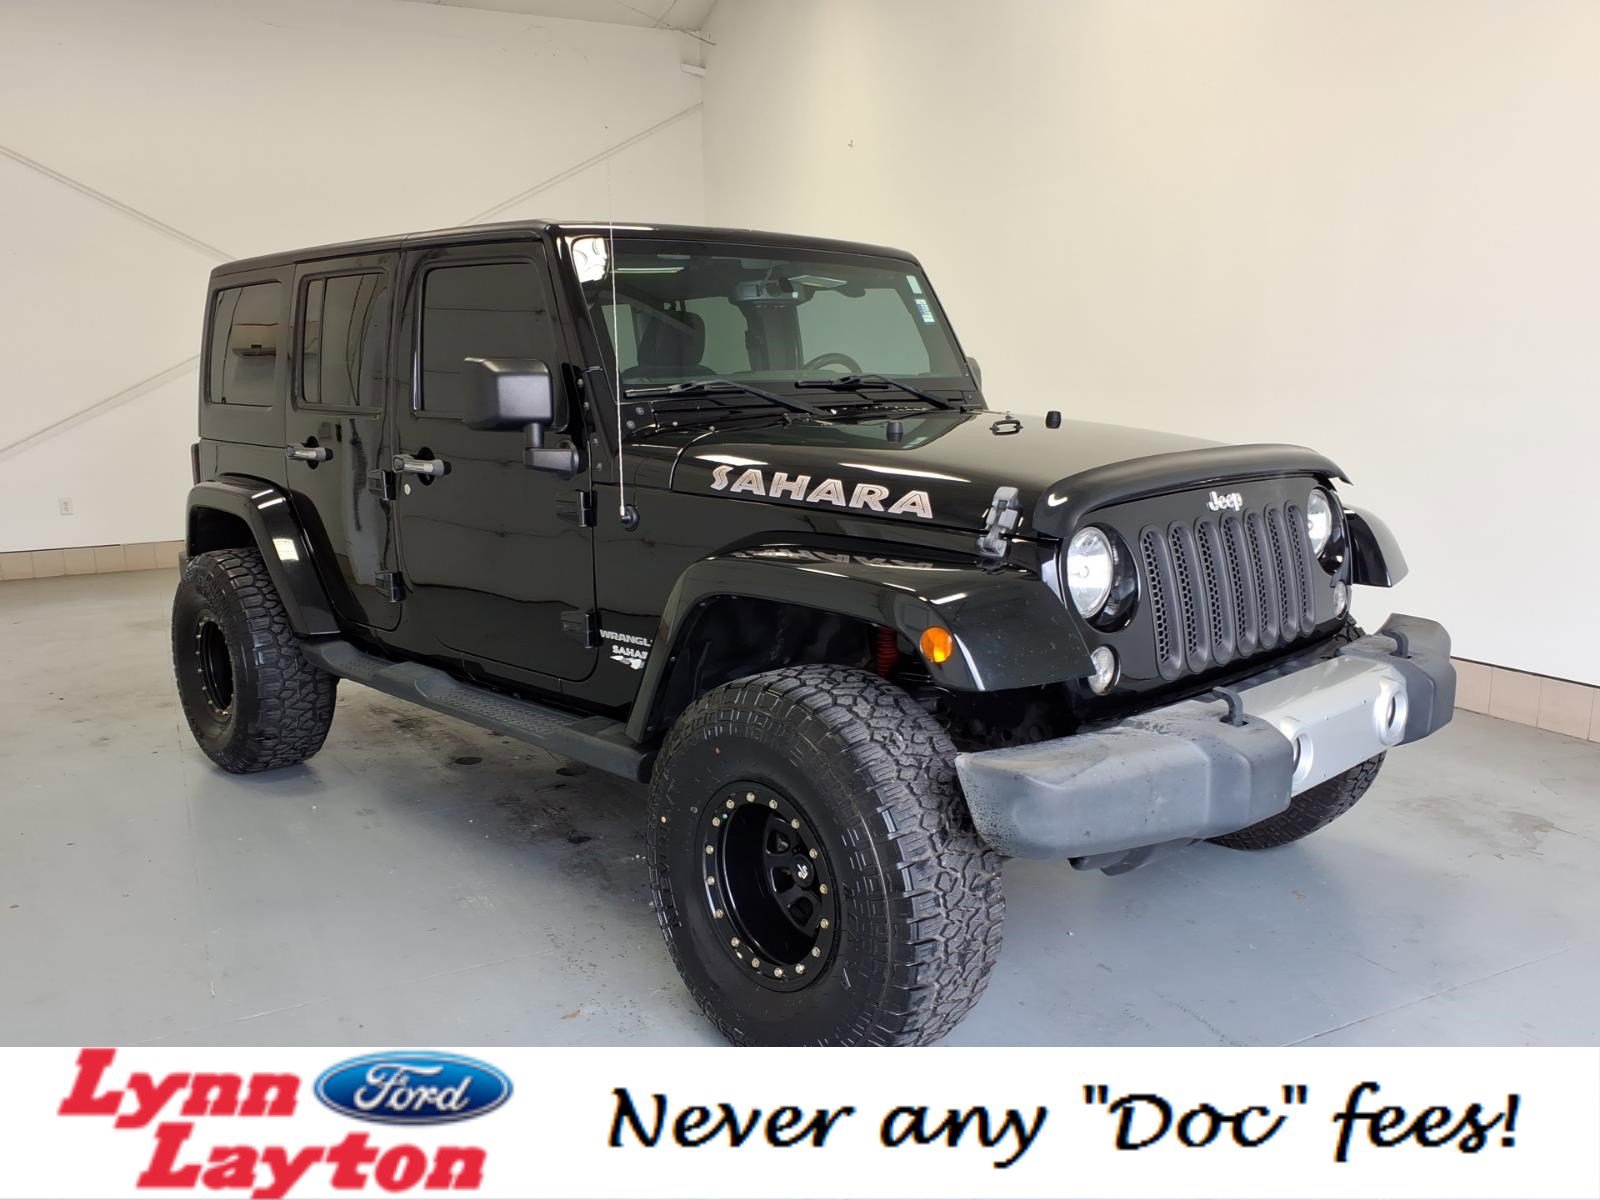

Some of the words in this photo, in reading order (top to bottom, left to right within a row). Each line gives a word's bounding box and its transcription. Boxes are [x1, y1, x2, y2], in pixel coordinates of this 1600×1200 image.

[710, 464, 933, 519] SAHARA
[1206, 490, 1243, 512] Jeep
[599, 629, 653, 647] WRANGL
